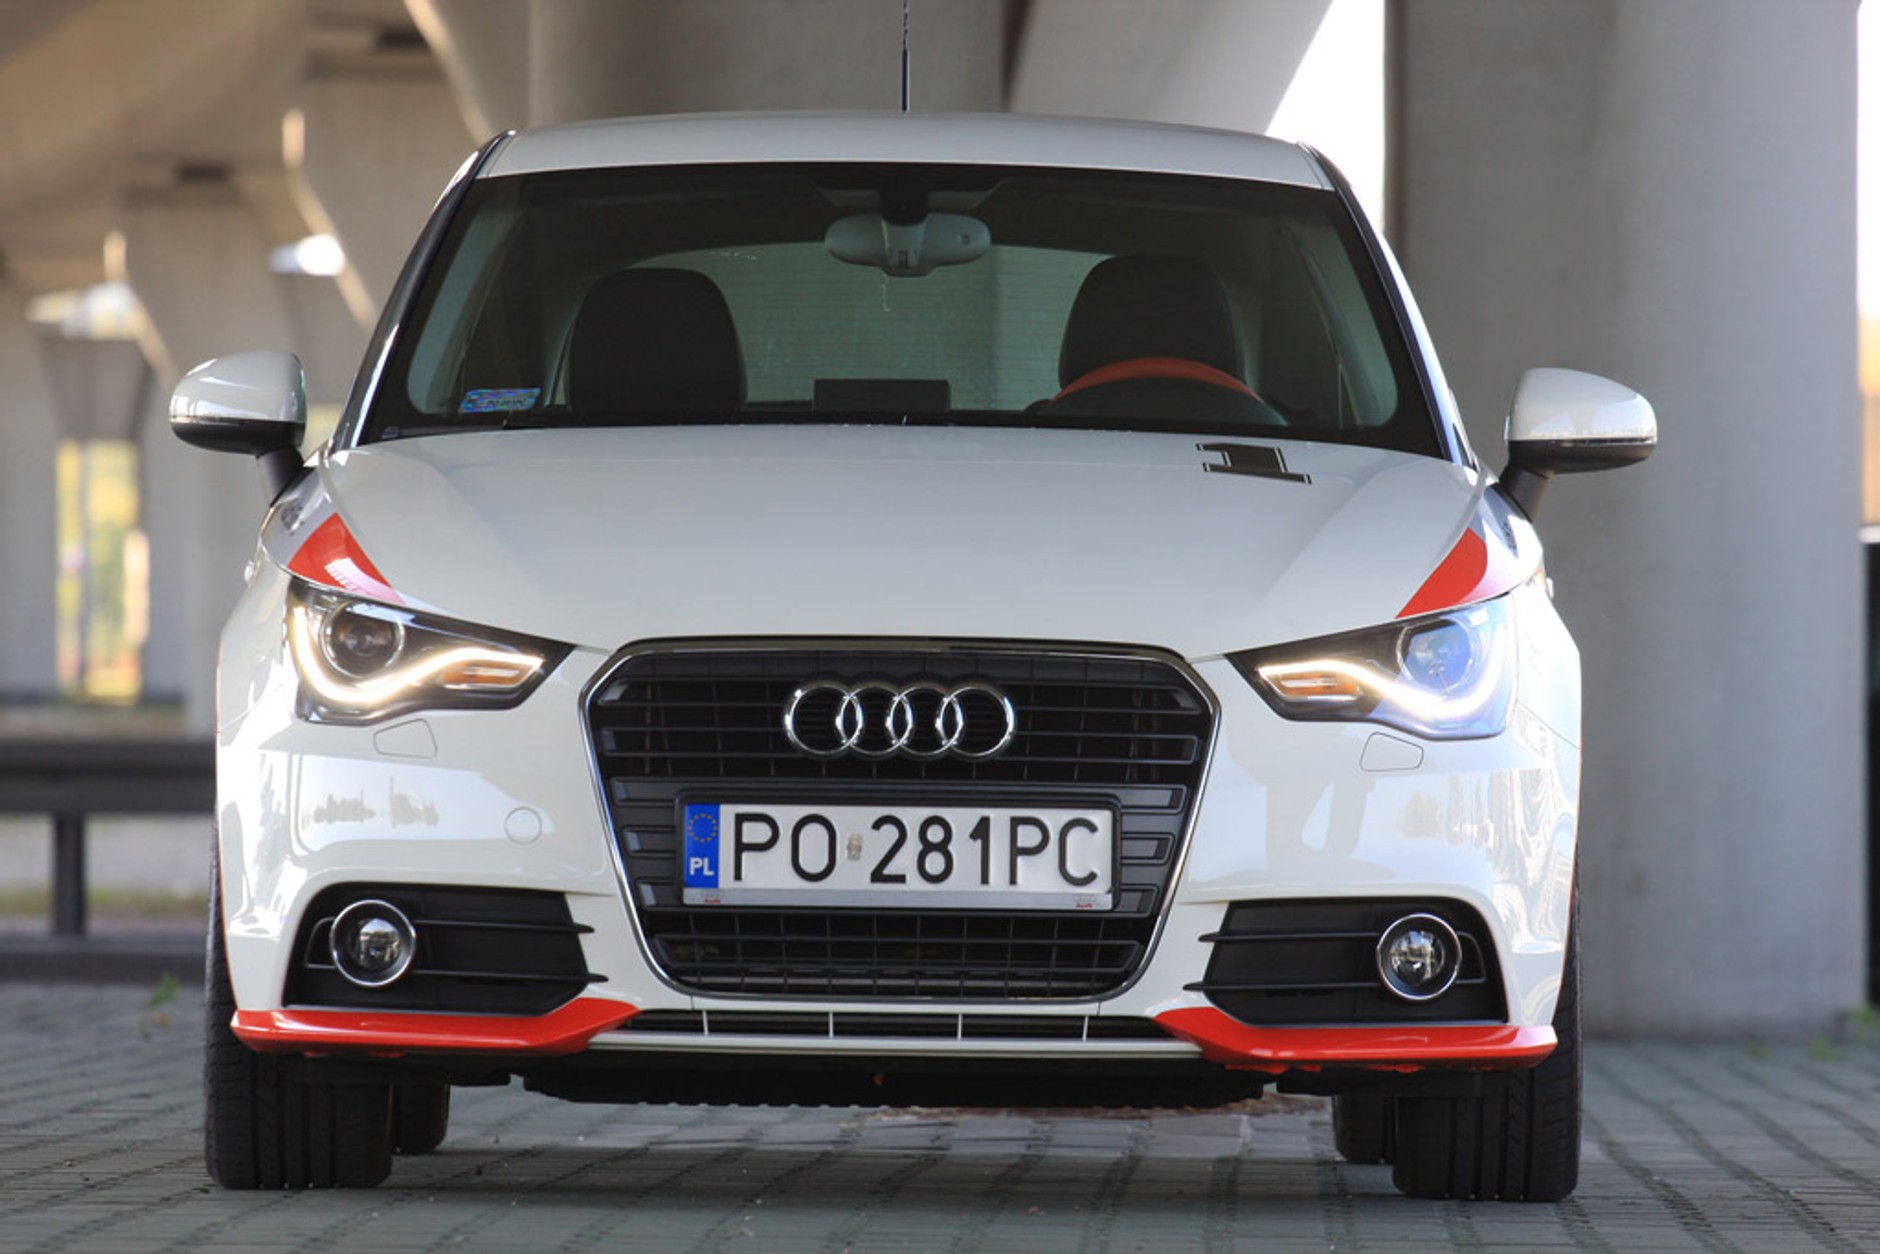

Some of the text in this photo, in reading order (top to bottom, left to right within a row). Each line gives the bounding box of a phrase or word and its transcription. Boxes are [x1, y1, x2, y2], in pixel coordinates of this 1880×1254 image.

[1195, 443, 1312, 485] 1
[690, 857, 714, 875] PL
[734, 812, 1098, 886] PO 281PC
